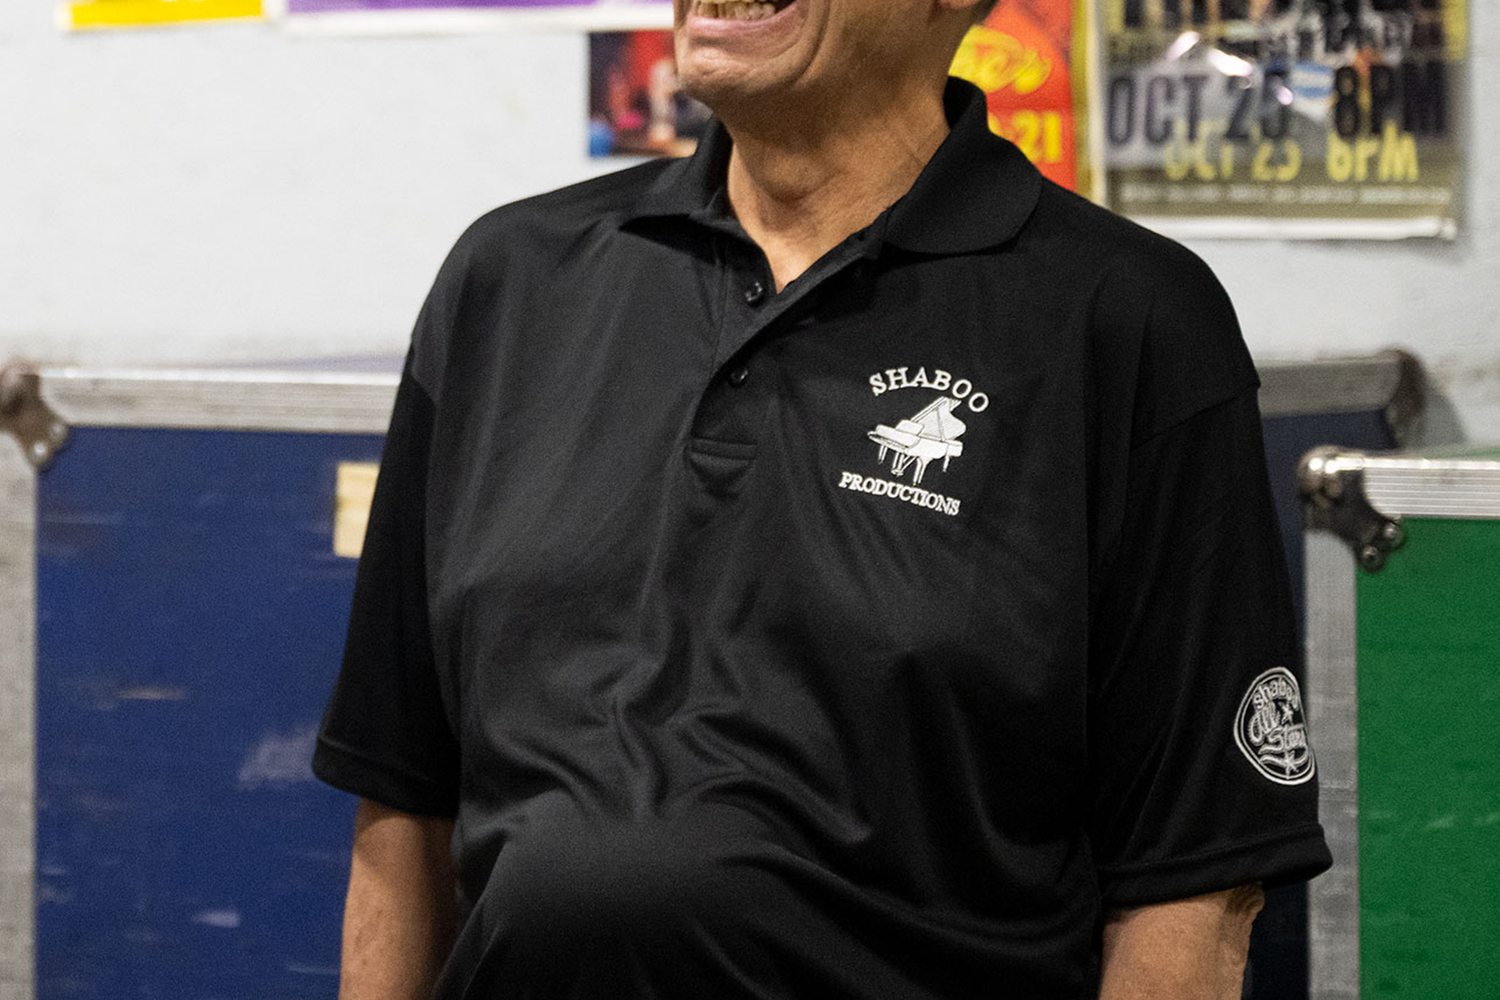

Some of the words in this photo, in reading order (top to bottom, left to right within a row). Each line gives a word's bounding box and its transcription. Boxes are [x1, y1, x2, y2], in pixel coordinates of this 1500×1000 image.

[1106, 72, 1206, 147] OCT
[868, 366, 989, 413] SHABOO
[838, 471, 962, 516] PRODUCTIONS
